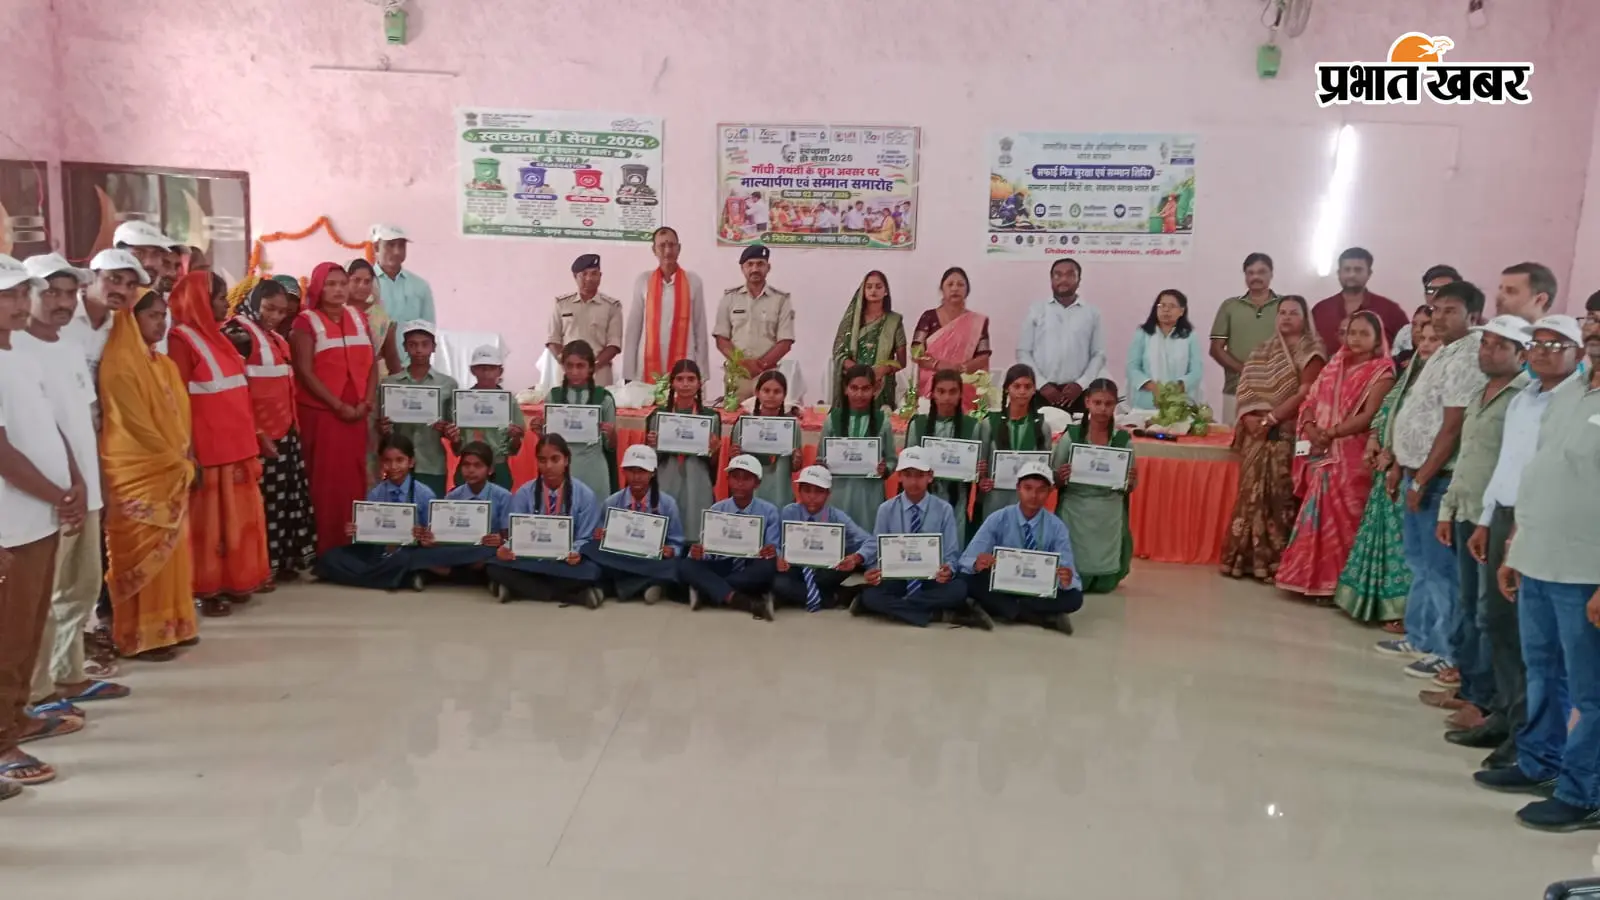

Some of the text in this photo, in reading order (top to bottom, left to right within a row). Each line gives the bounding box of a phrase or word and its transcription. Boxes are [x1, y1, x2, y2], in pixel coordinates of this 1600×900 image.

[478, 131, 541, 143] स्वच्छता
[545, 131, 562, 143] ही
[566, 131, 597, 145] सेवा
[806, 165, 814, 175] के
[817, 167, 835, 178] शुभ
[837, 167, 865, 176] अवसर
[867, 168, 880, 177] पर
[1037, 165, 1058, 178] सफाई
[1059, 165, 1073, 178] मित्र
[1074, 168, 1094, 179] सुरक्षा
[1095, 166, 1106, 179] एवं
[1107, 168, 1130, 177] सम्मान
[741, 175, 894, 191] माल्यार्पण एवं सम्मान समारोह
